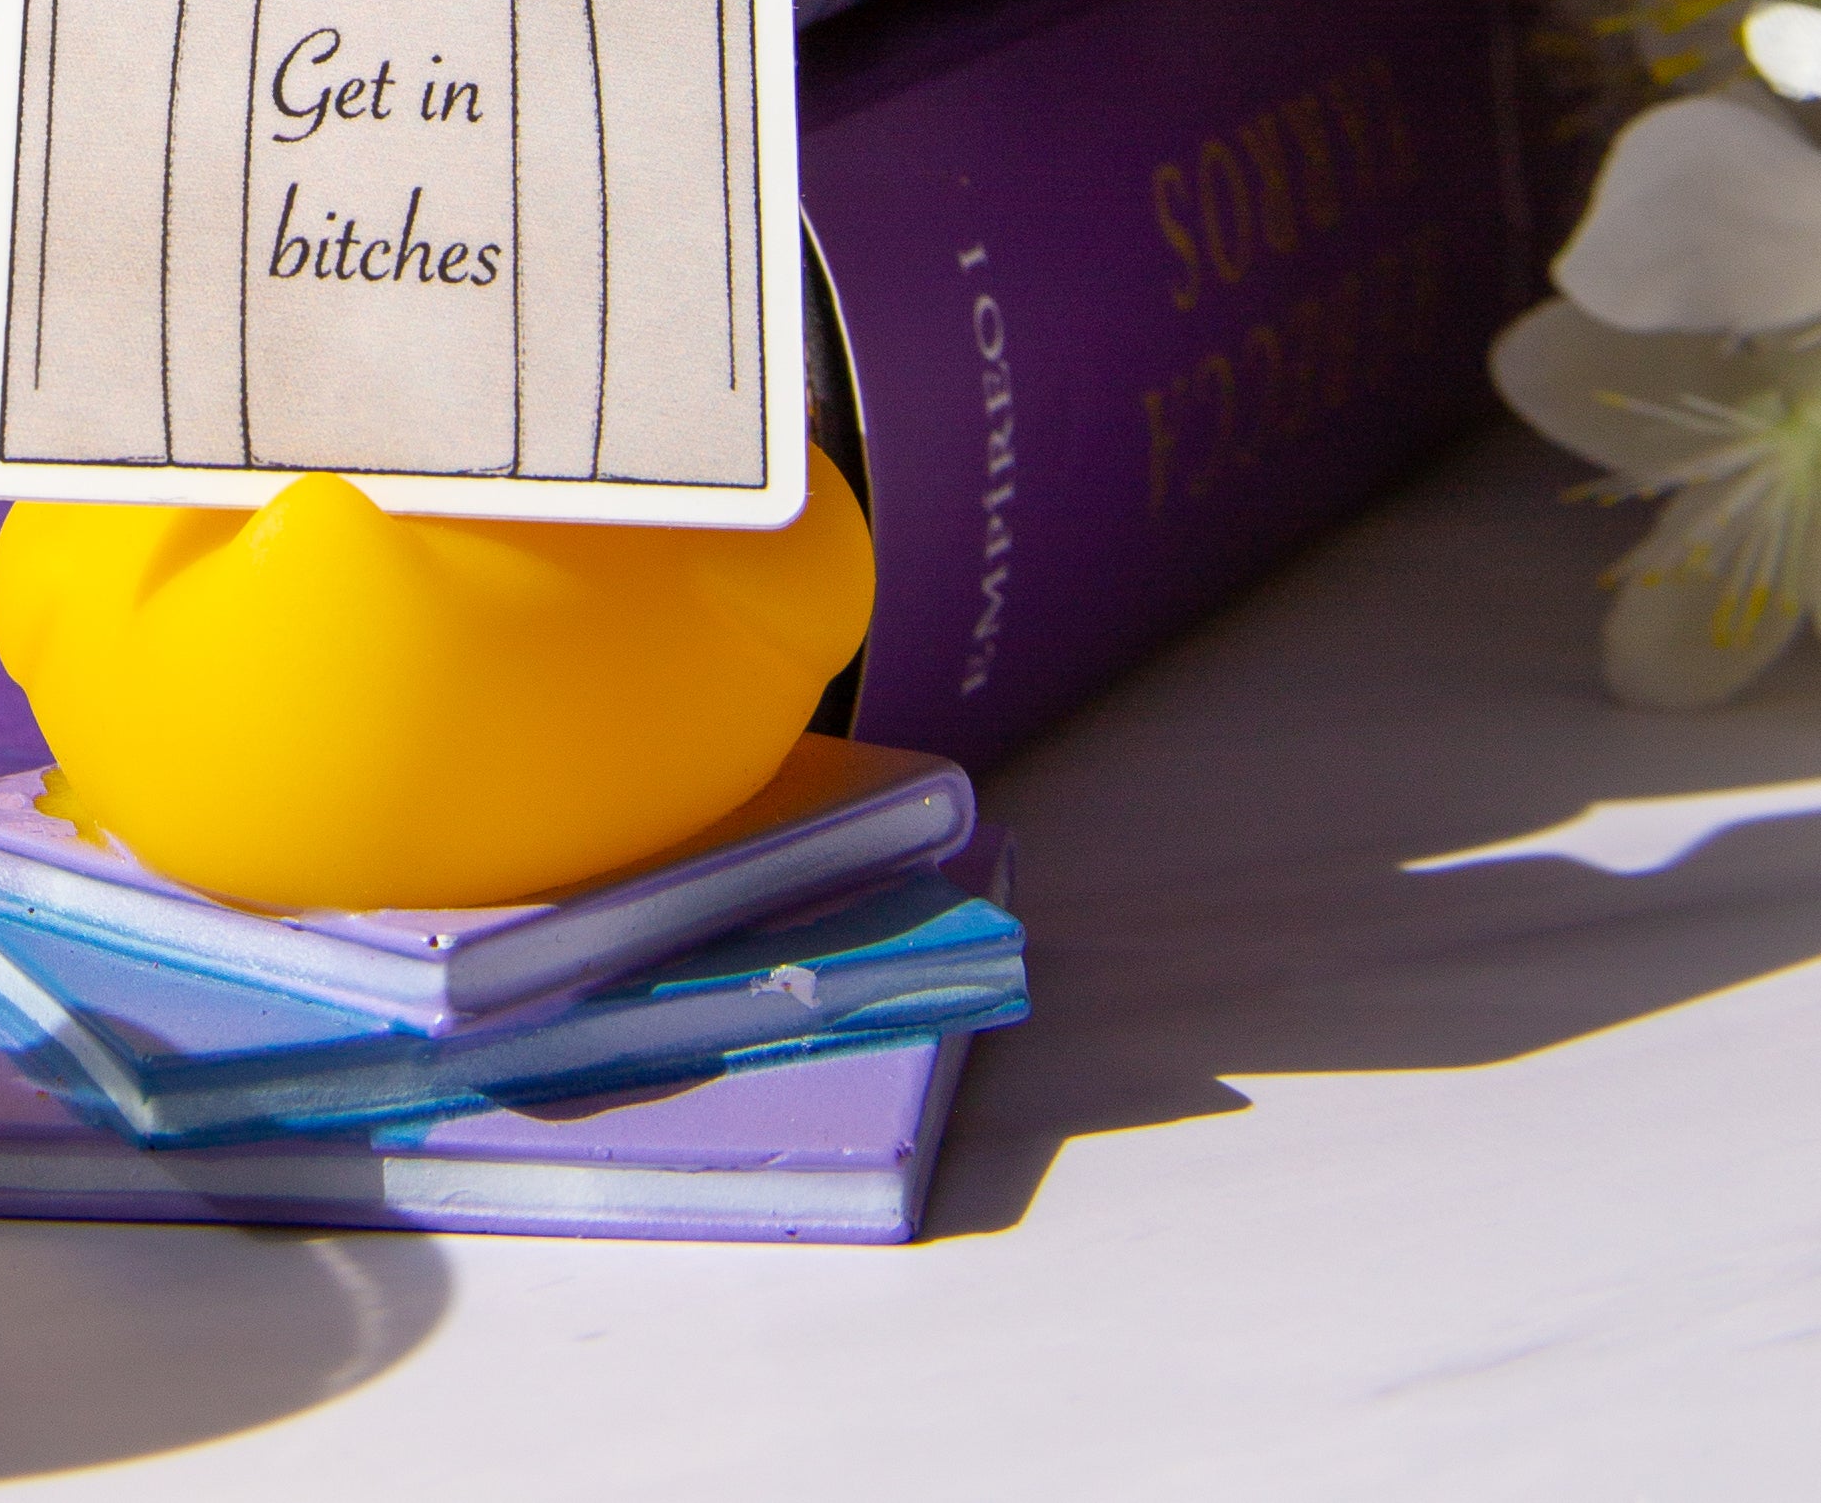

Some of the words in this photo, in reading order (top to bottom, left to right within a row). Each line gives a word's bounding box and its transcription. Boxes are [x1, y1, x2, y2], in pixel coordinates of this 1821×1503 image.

[271, 28, 397, 141] Get
[420, 55, 483, 123] in
[268, 183, 501, 284] bitches
